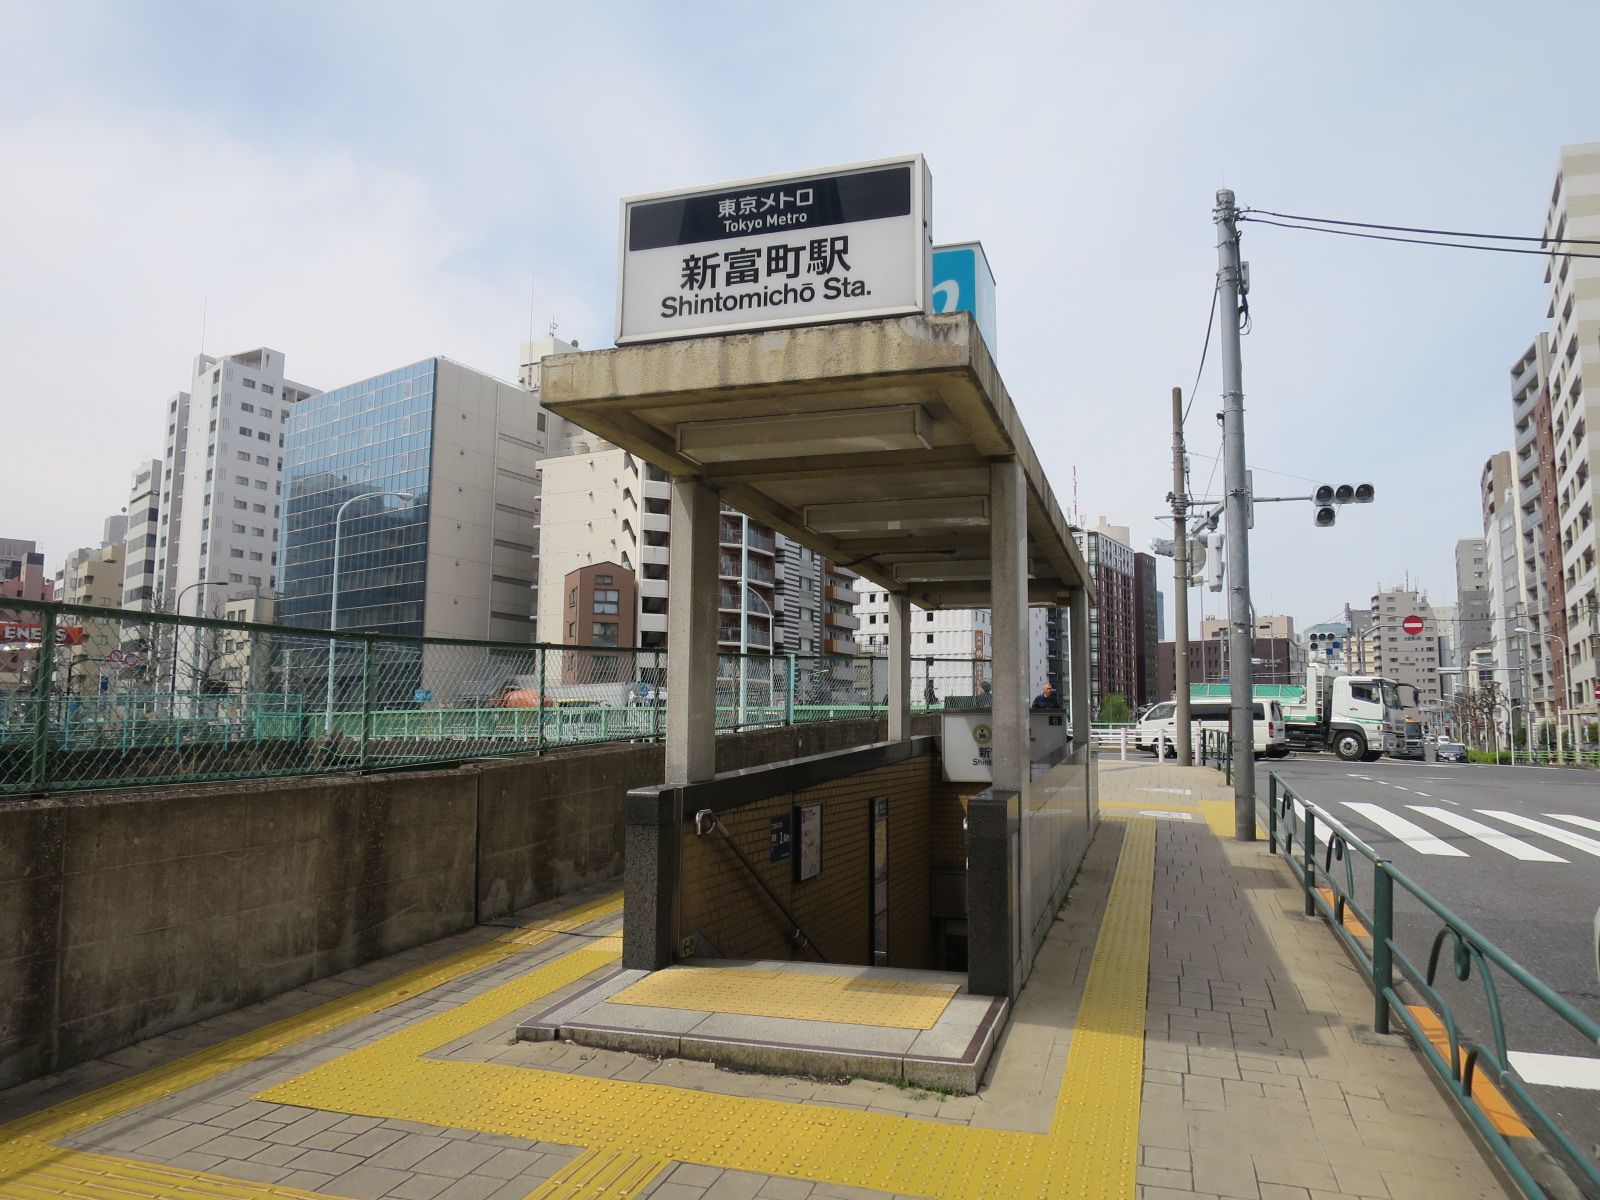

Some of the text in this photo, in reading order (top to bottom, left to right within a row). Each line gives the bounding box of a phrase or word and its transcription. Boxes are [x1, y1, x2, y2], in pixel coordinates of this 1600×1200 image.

[717, 188, 814, 218] 東京メトロ
[723, 212, 808, 233] Tokyo Metro
[680, 235, 852, 291] 新富町駅
[660, 276, 872, 319] Shintomichō Sta.
[5, 626, 66, 641] ENES
[979, 747, 992, 758] 新
